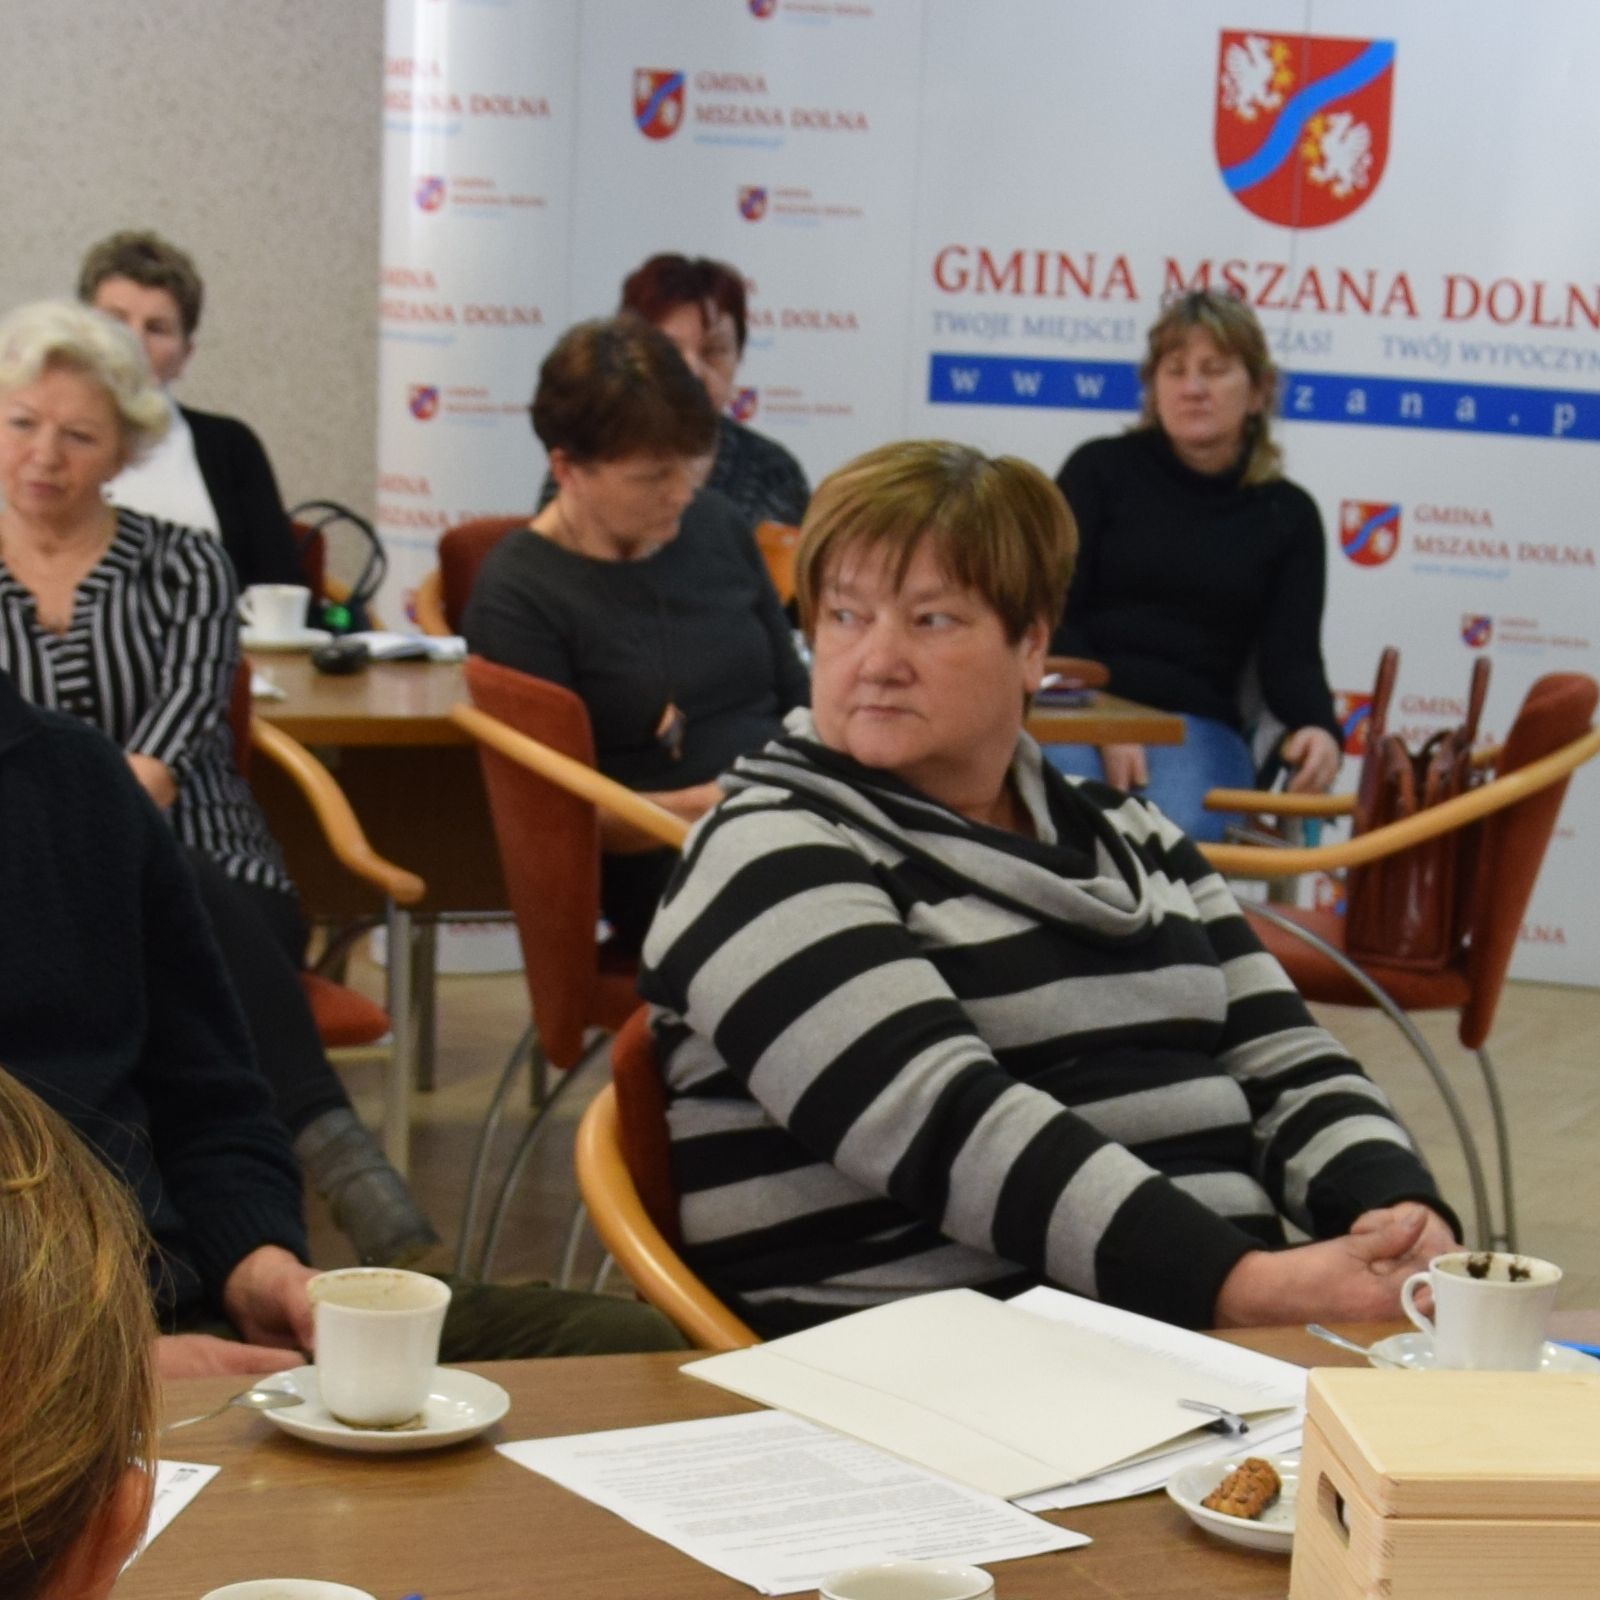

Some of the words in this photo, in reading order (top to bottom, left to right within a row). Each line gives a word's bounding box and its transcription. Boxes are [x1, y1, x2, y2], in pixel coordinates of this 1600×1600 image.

[695, 72, 769, 93] GMINA
[469, 94, 550, 118] DOLNA
[695, 104, 785, 126] MSZANA
[790, 107, 869, 131] DOLNA
[933, 245, 1139, 302] GMINA
[1163, 256, 1419, 320] MSZANA
[462, 304, 544, 328] DOLNA
[781, 309, 859, 331] DOLNA
[1414, 504, 1492, 528] GMINA
[1413, 535, 1510, 560] MSZANA
[1517, 542, 1595, 567] DOLNA
[1401, 694, 1466, 717] GMIN
